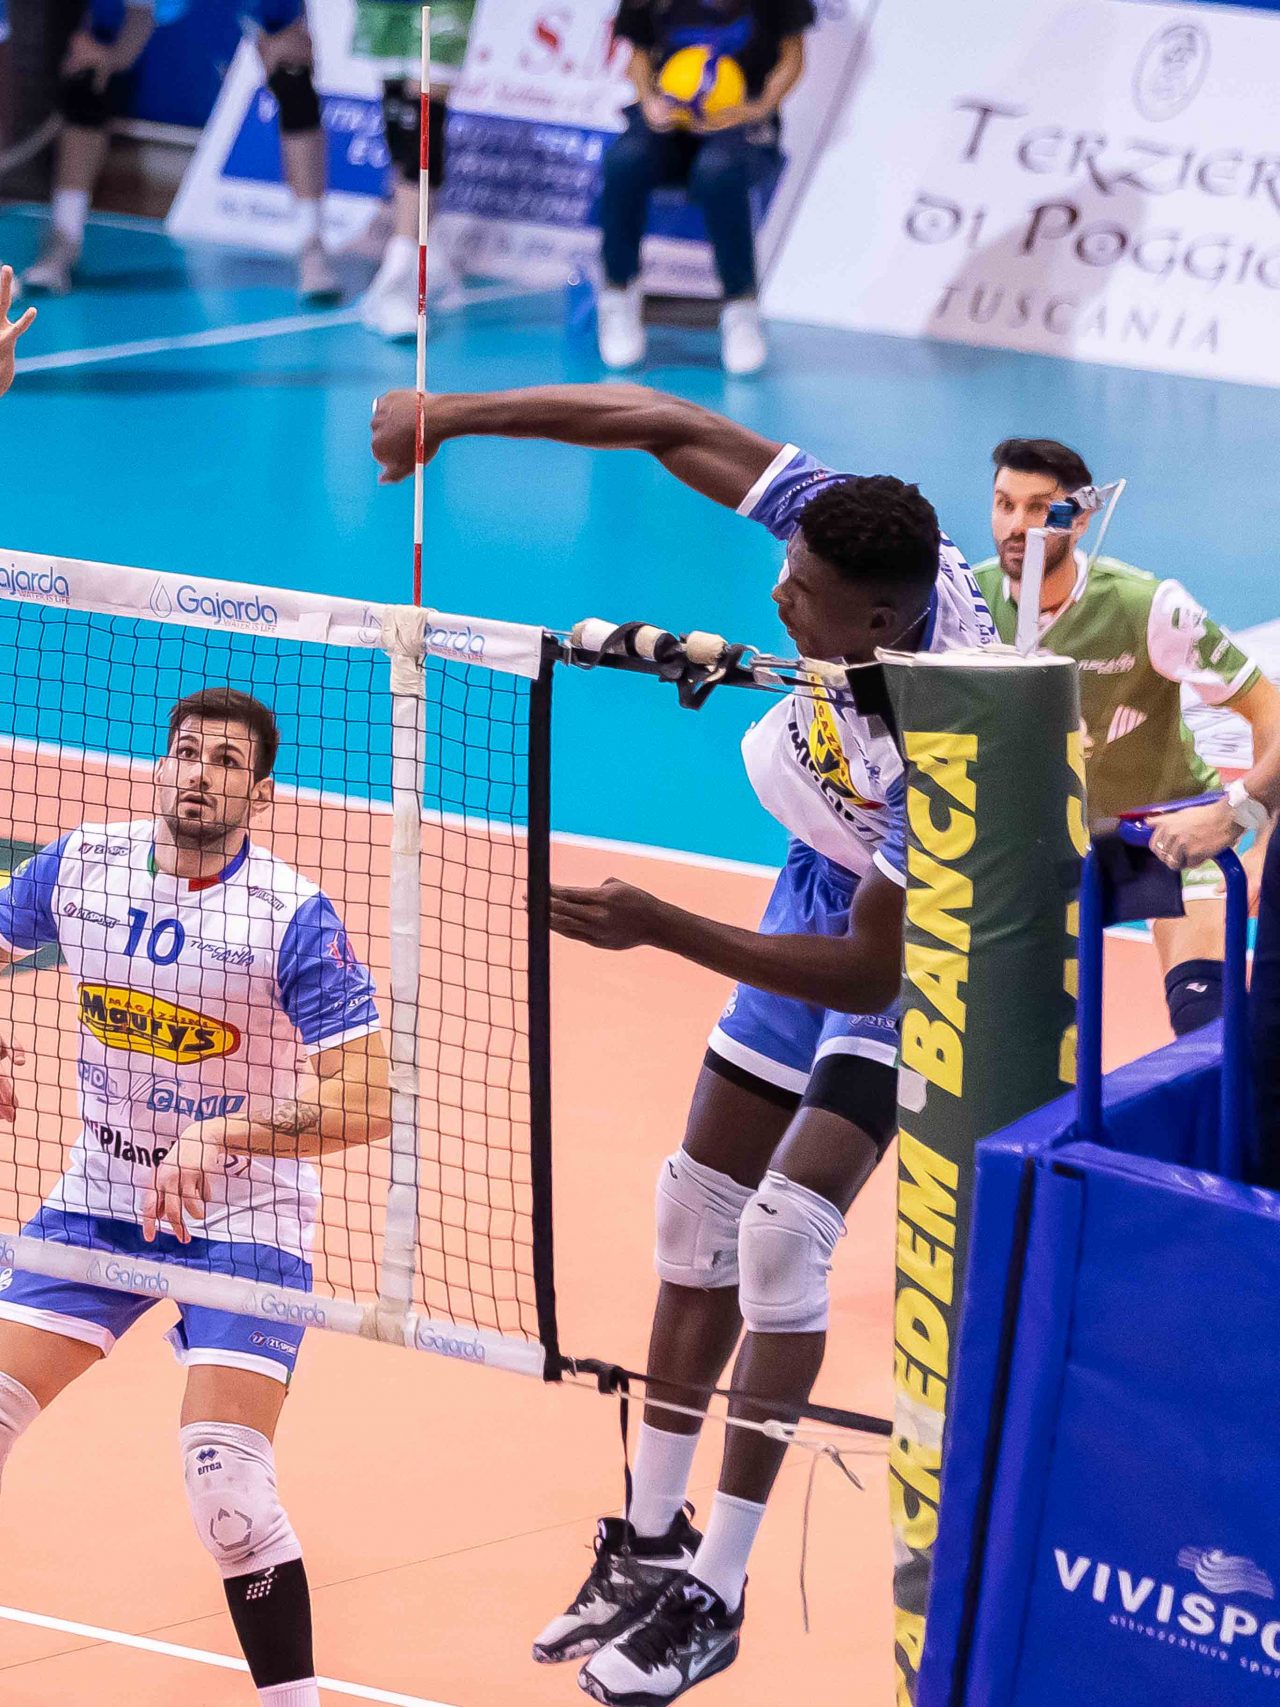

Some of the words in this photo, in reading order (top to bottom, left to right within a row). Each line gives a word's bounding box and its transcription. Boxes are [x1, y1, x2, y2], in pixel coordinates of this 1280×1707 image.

[933, 284, 1221, 355] TUSCANIA
[177, 584, 278, 625] Gajarda
[223, 619, 250, 629] WATER
[260, 622, 277, 633] LIFE
[900, 731, 979, 1099] BANCA
[123, 906, 186, 967] 10
[105, 1262, 169, 1292] Gajarda
[261, 1294, 326, 1325] Gajarda
[419, 1327, 486, 1361] Gajarda
[197, 1461, 223, 1476] errea
